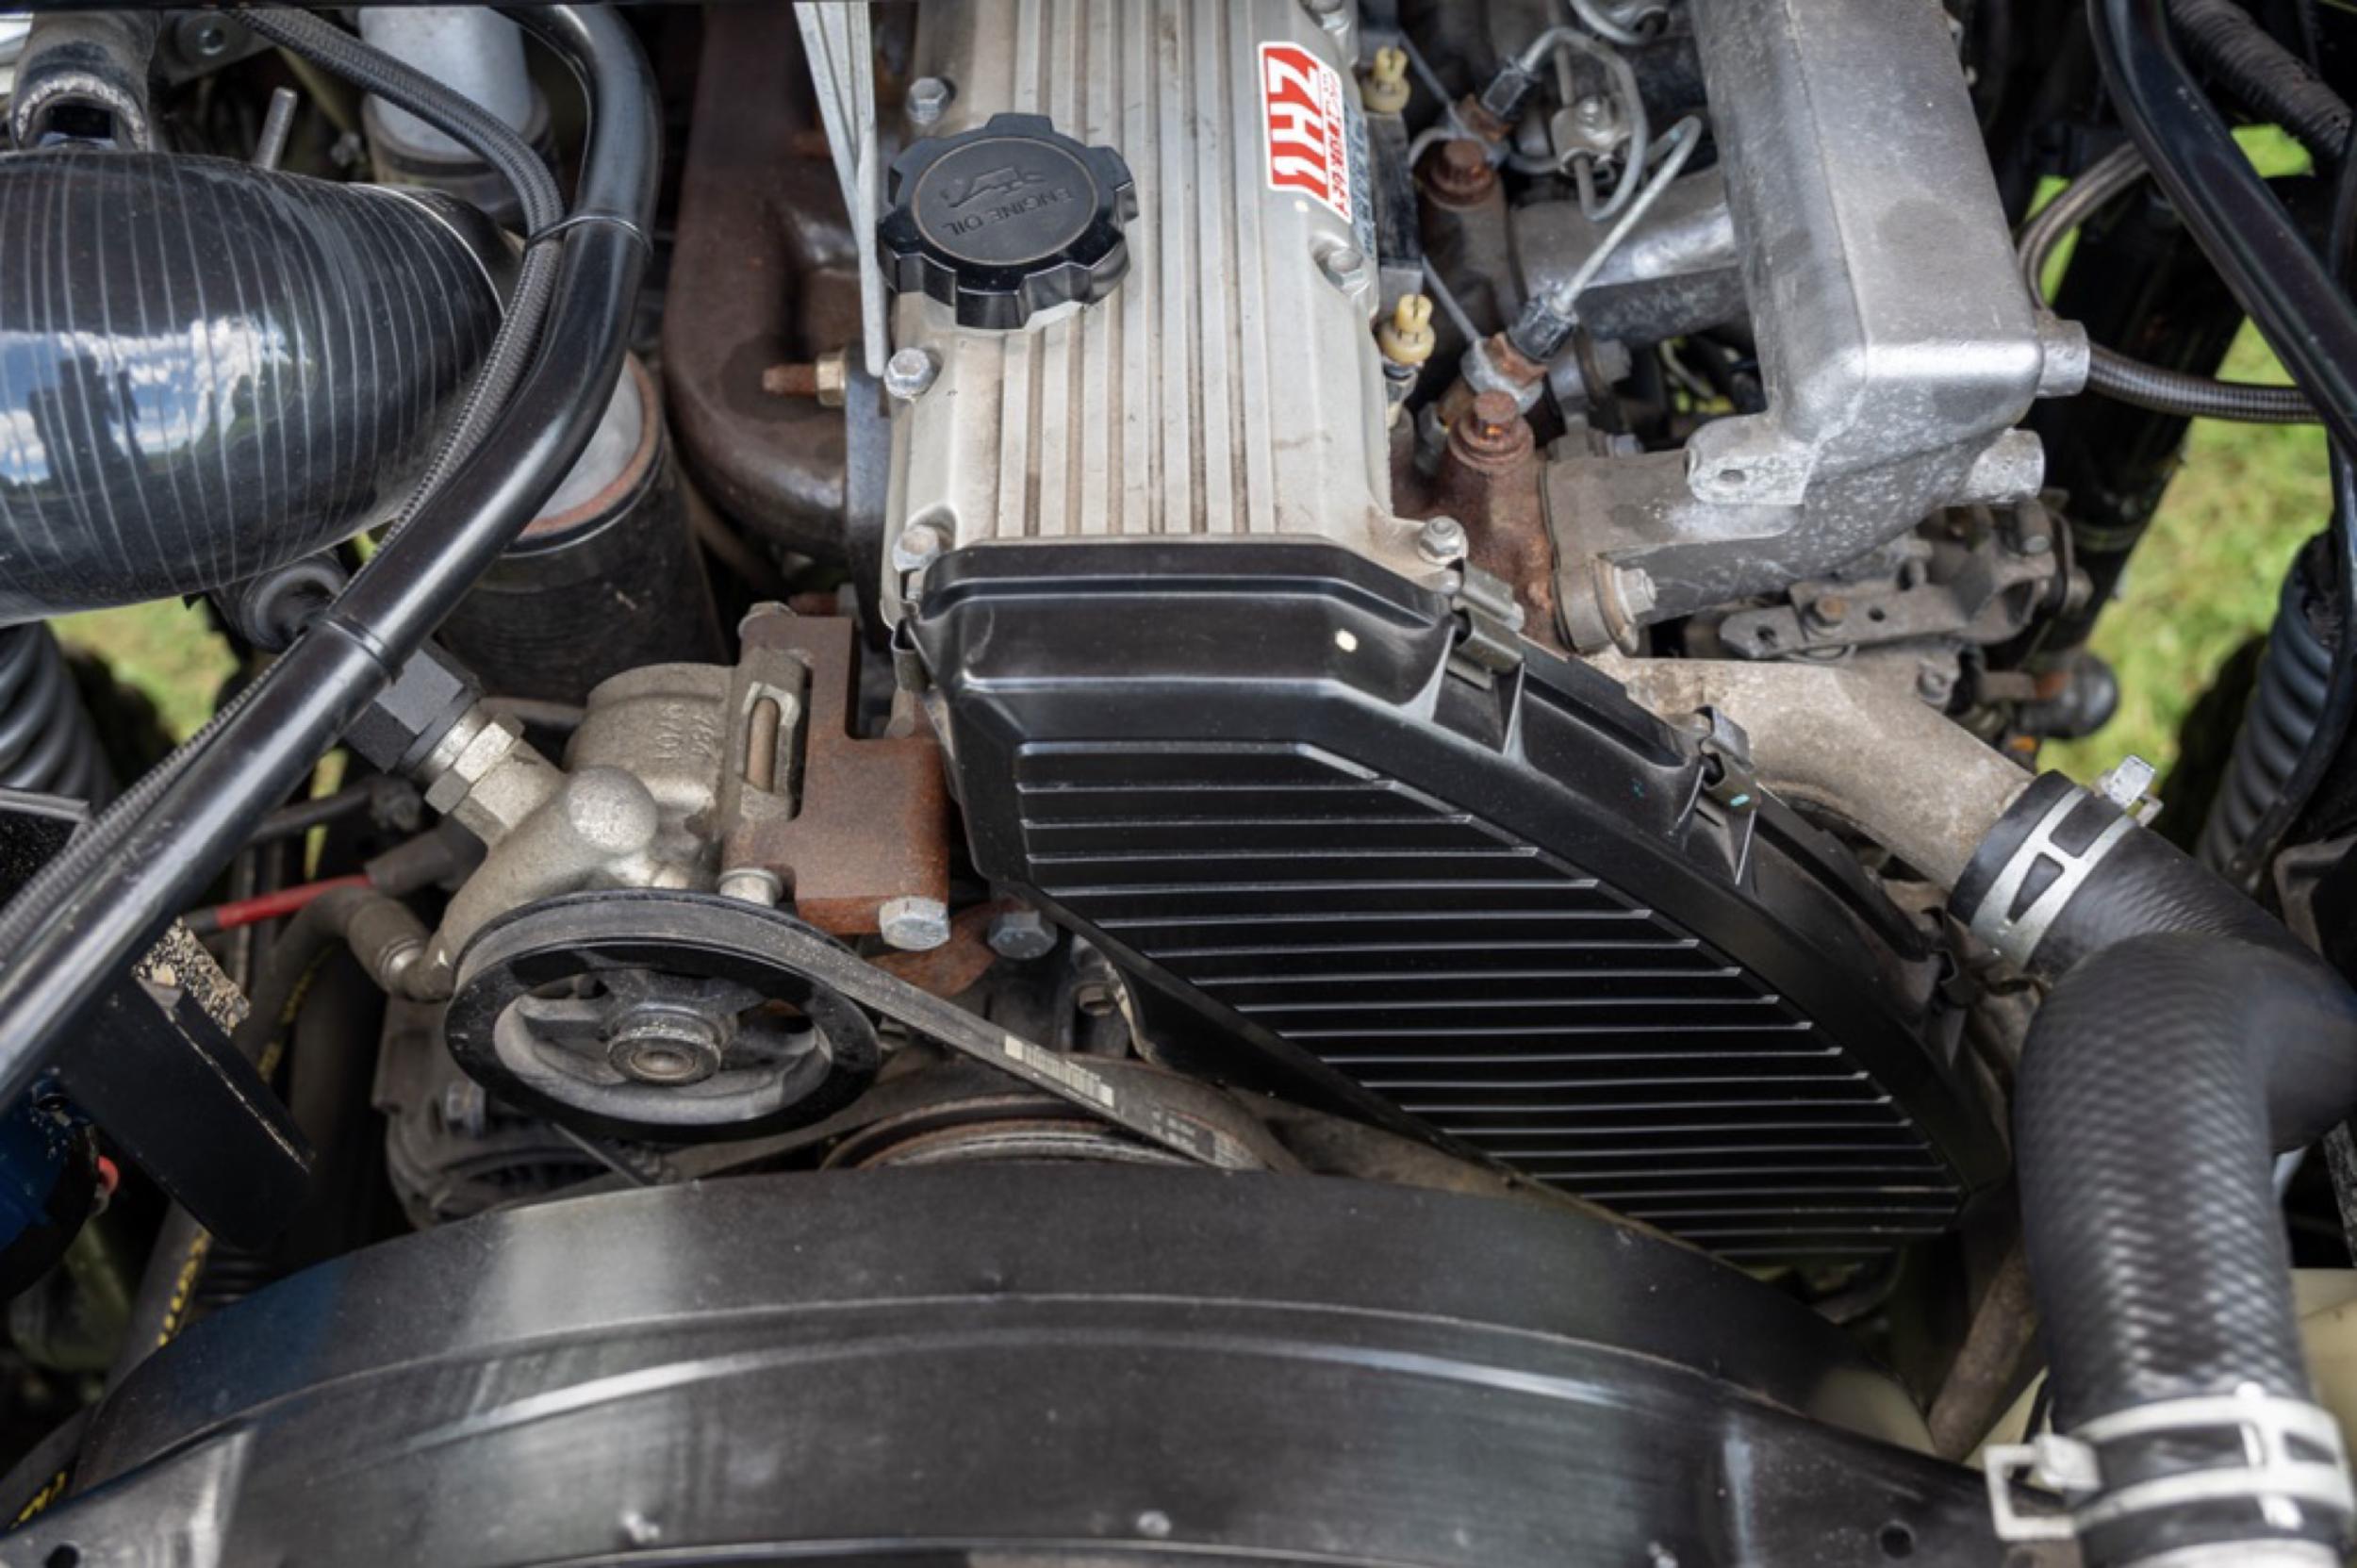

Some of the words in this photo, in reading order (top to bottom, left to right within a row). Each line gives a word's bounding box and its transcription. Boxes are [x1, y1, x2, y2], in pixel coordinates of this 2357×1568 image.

[1267, 57, 1327, 177] 1HZ
[987, 187, 1073, 223] ENGINE
[943, 213, 983, 236] OIL
